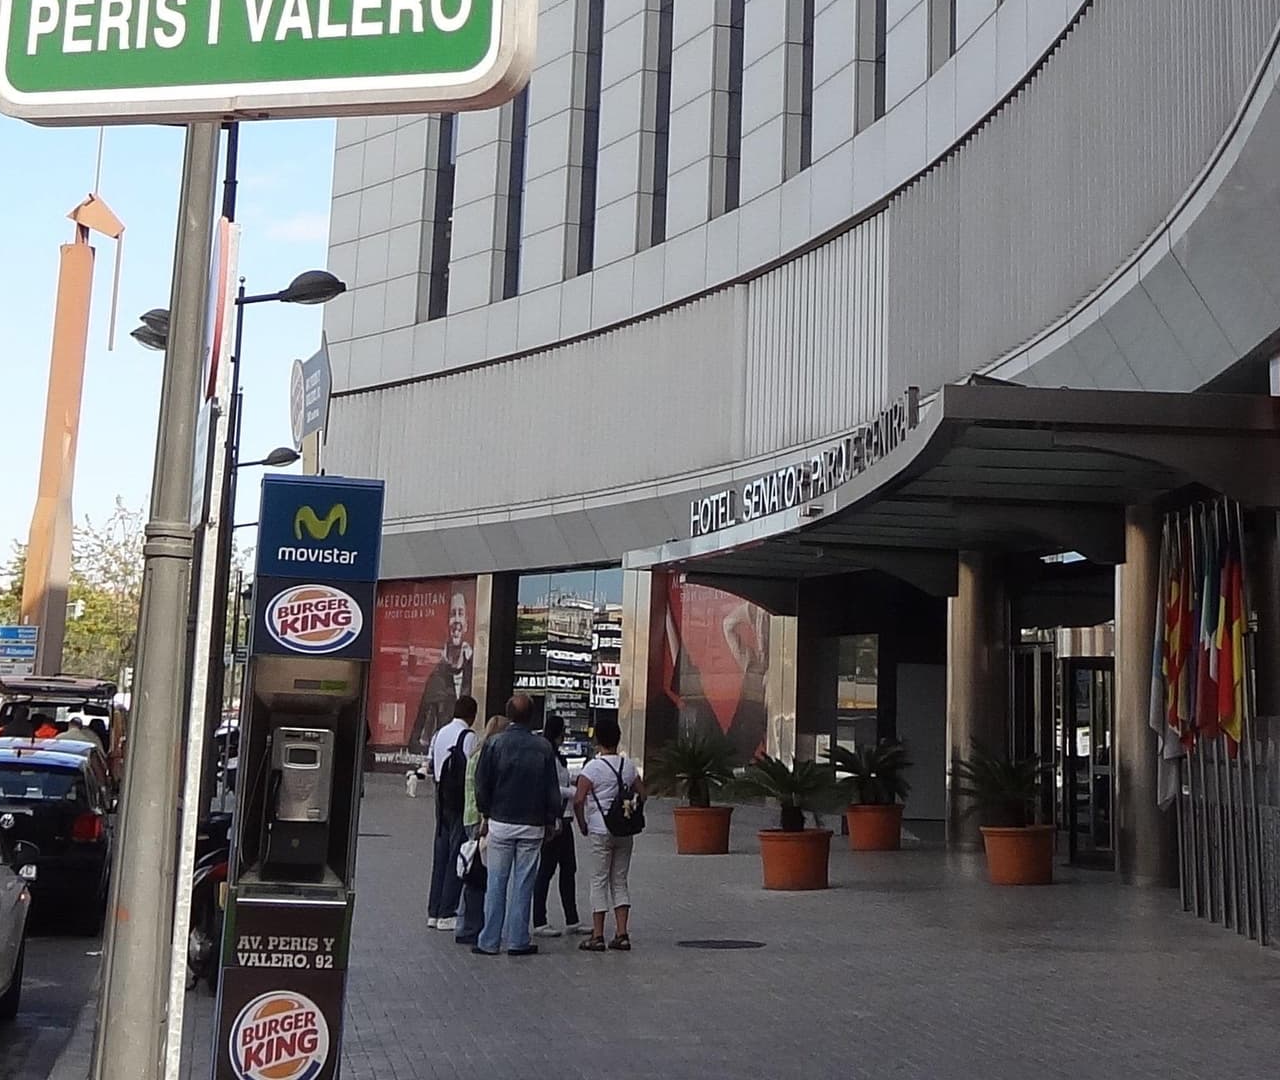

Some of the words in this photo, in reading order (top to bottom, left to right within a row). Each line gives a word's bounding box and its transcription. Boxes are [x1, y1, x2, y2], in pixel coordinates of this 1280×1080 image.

[690, 490, 735, 536] HOTEL
[743, 464, 804, 521] SENATOR
[810, 427, 866, 498] PARQUE
[278, 546, 357, 564] movistar
[277, 598, 349, 620] BURGER
[377, 593, 445, 608] METROPOLITAN
[280, 610, 352, 636] KING
[237, 936, 263, 950] AV.
[267, 936, 319, 952] PERIS
[323, 938, 335, 952] Y
[237, 952, 311, 969] VALERO,
[315, 955, 334, 969] 92
[242, 1011, 316, 1047] BURGER
[242, 1028, 318, 1073] KING
